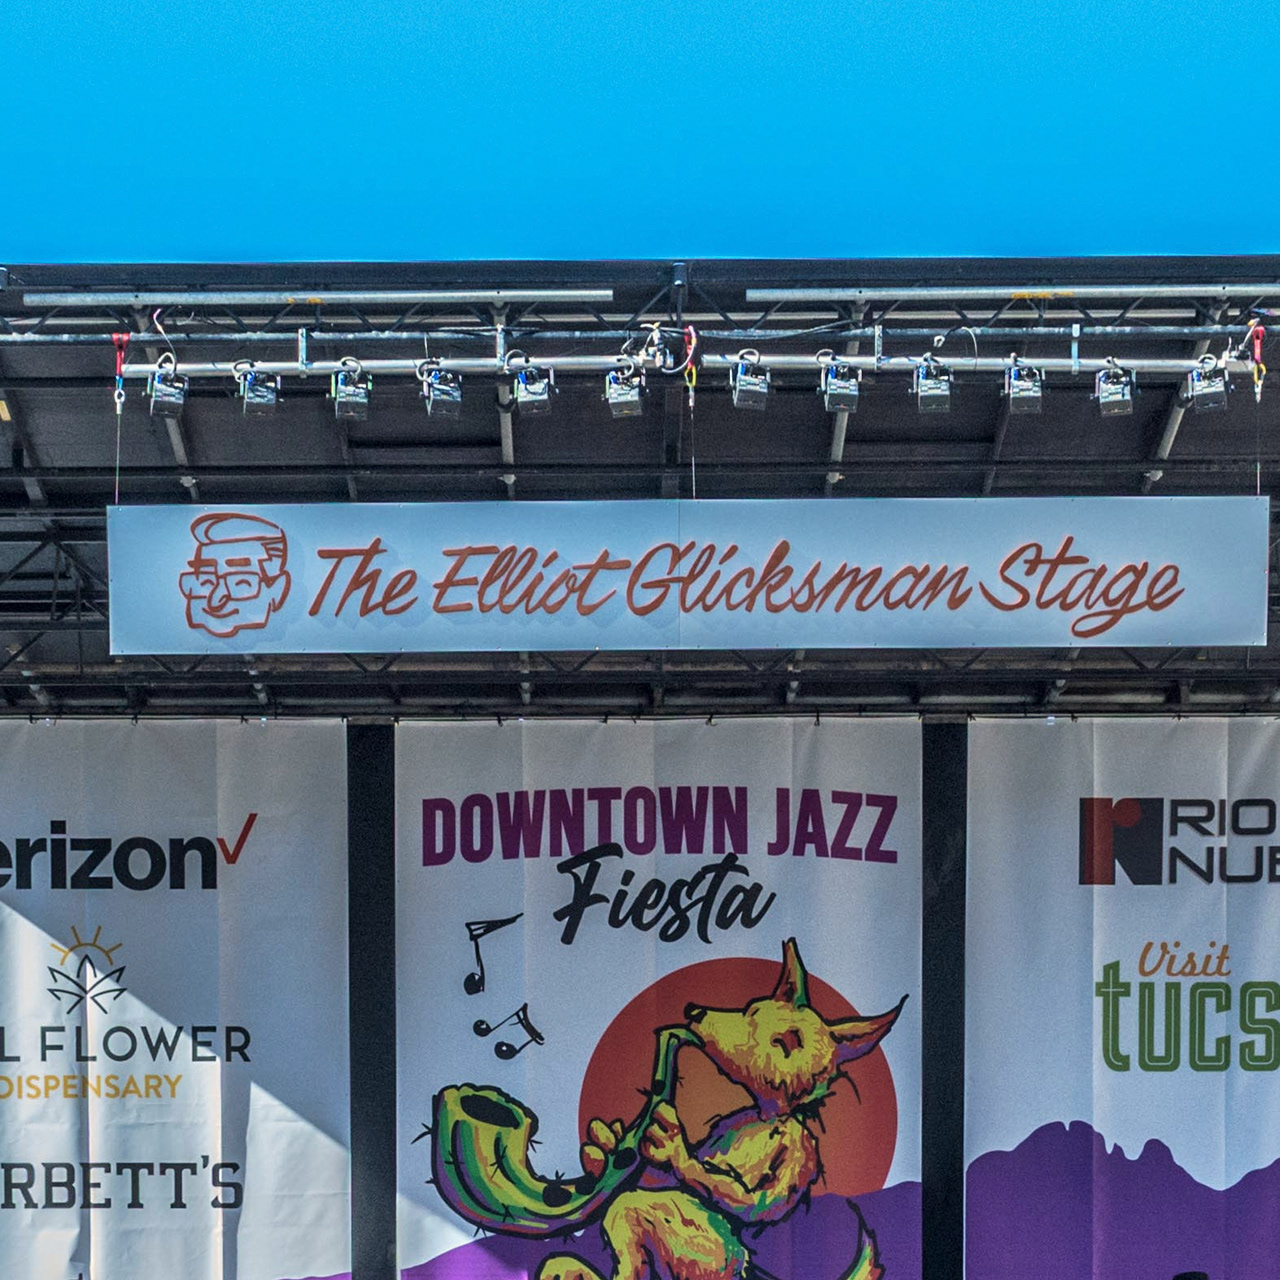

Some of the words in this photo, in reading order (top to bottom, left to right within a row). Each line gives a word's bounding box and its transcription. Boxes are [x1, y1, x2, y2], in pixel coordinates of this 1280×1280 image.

[309, 540, 417, 616] The
[433, 547, 627, 615] Elliot
[623, 541, 972, 617] Glicksman
[979, 537, 1184, 638] Stage
[422, 786, 748, 866] DOWNTOWN
[768, 787, 899, 864] JAZZ
[1169, 798, 1277, 837] RIO
[553, 841, 777, 945] Fiesta
[1138, 941, 1232, 978] Visit
[41, 1026, 252, 1063] FLOWER
